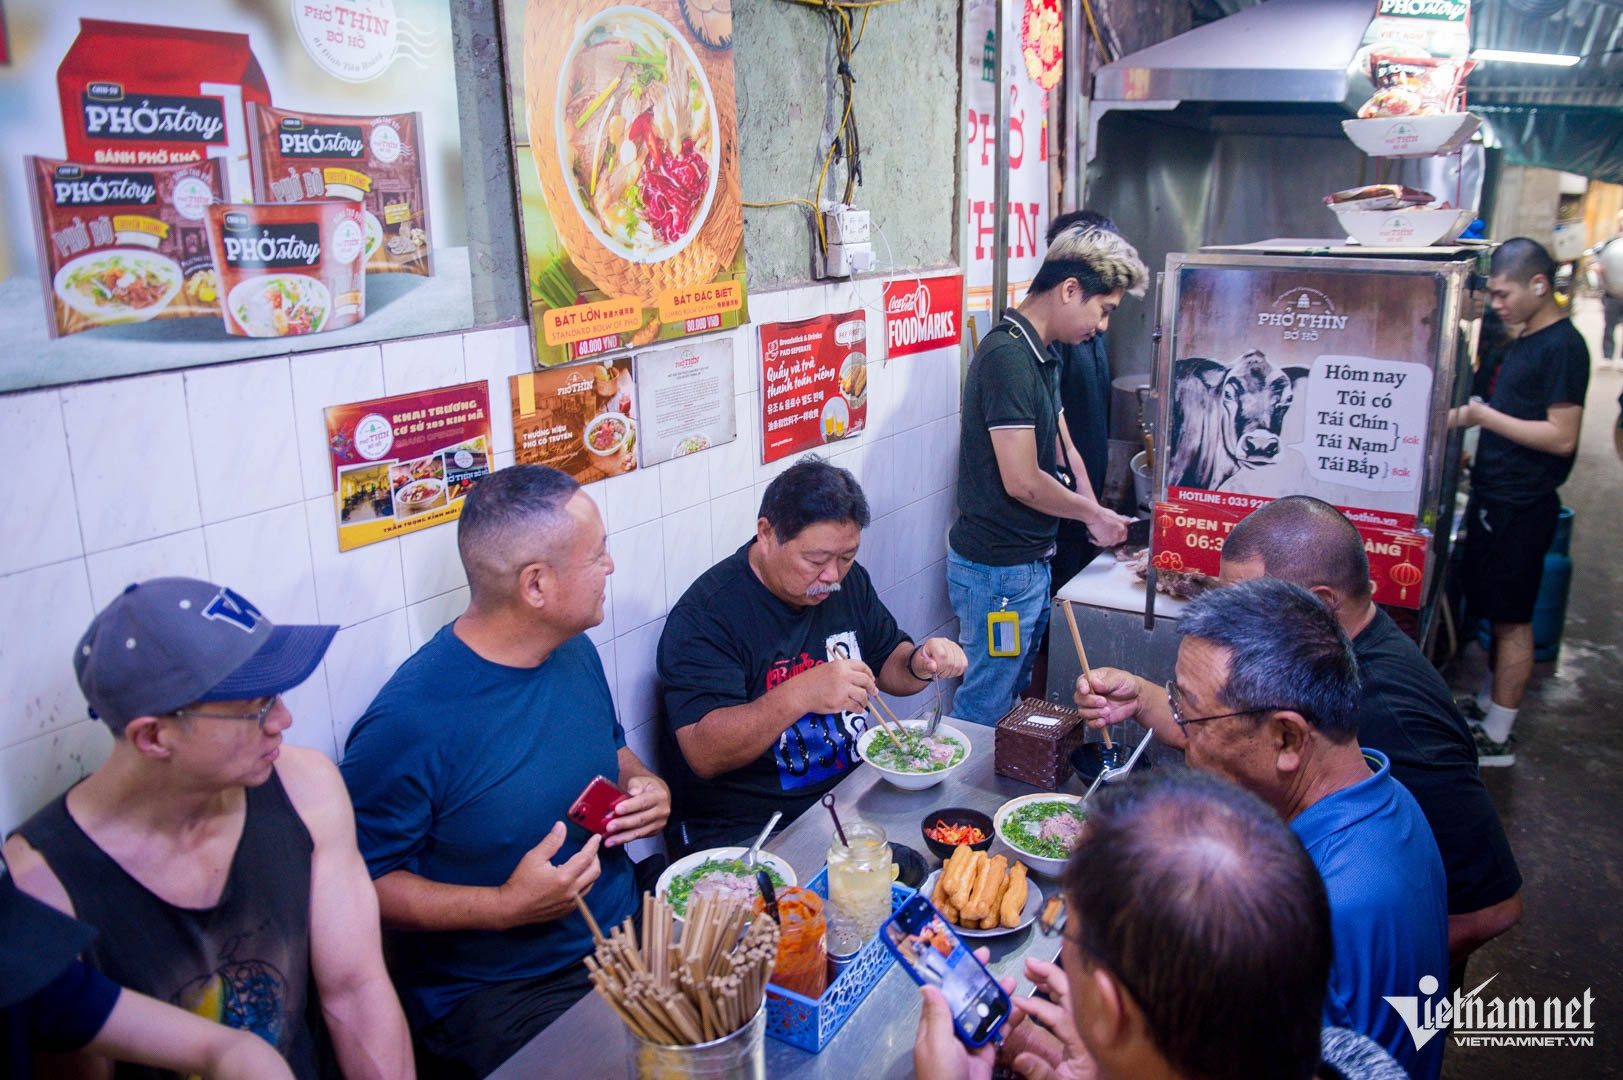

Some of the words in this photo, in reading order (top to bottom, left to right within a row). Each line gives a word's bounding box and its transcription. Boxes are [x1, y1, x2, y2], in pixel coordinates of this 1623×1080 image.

[335, 6, 389, 37] THÌN
[94, 148, 136, 164] BÁNH
[673, 289, 692, 306] BÁT
[694, 290, 713, 304] ĐẶC
[715, 287, 733, 300] BIỆT
[554, 309, 577, 328] BÁT
[1257, 306, 1296, 327] PHỞ
[1295, 310, 1349, 330] THÌN
[551, 327, 591, 341] STANDARD
[578, 337, 603, 355] 60.000
[790, 360, 801, 376] và
[801, 355, 815, 372] trà
[767, 378, 794, 399] thanh
[794, 373, 812, 390] toán
[813, 365, 836, 382] riêng
[1324, 364, 1369, 382] Hôm
[1371, 370, 1408, 390] nay
[1336, 390, 1367, 407] Tôi
[1371, 392, 1393, 409] có
[392, 409, 427, 424] KHAI
[446, 414, 467, 426] KIM
[467, 408, 484, 420] MÃ
[1317, 411, 1344, 427] Tái
[1349, 413, 1389, 430] Chín
[1316, 433, 1342, 449] Tái
[1346, 436, 1389, 456] Nạm
[1317, 456, 1345, 472] Tái
[1346, 457, 1380, 479] Bắp
[1178, 490, 1221, 504] HOTLINE
[1227, 496, 1249, 508] 033
[1175, 516, 1218, 532] OPEN
[1342, 510, 1398, 527] hothin.vn
[1185, 533, 1225, 551] 06:3
